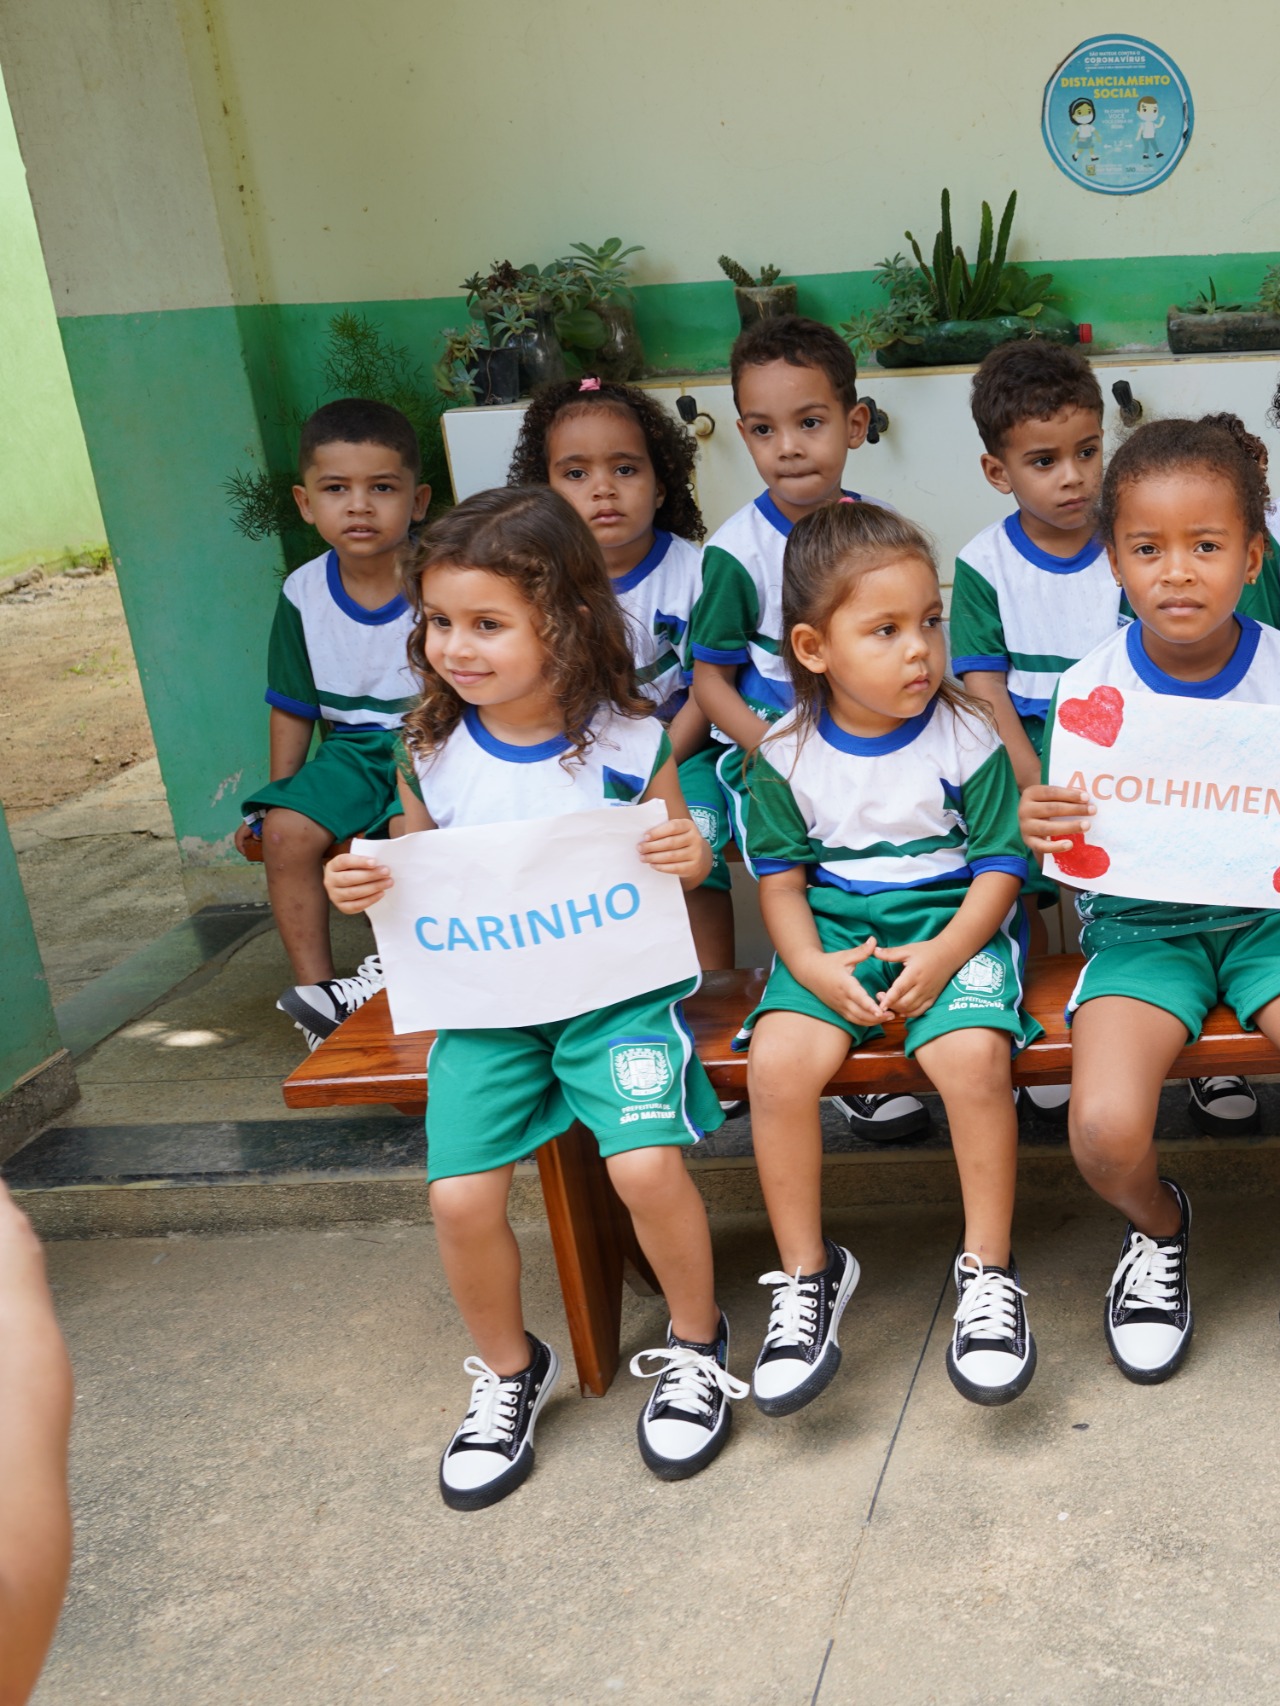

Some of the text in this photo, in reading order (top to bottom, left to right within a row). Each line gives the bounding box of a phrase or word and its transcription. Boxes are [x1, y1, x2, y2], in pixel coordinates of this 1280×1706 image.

[1084, 55, 1146, 64] CORONAVÍRUS
[1060, 75, 1171, 88] DISTANCIAMENTO
[1093, 88, 1139, 99] SOCIAL
[414, 882, 641, 951] CARINHO
[948, 1001, 968, 1011] SÃO
[622, 1103, 662, 1113] PREFEITURA
[620, 1111, 676, 1124] SÃO MATEUS
